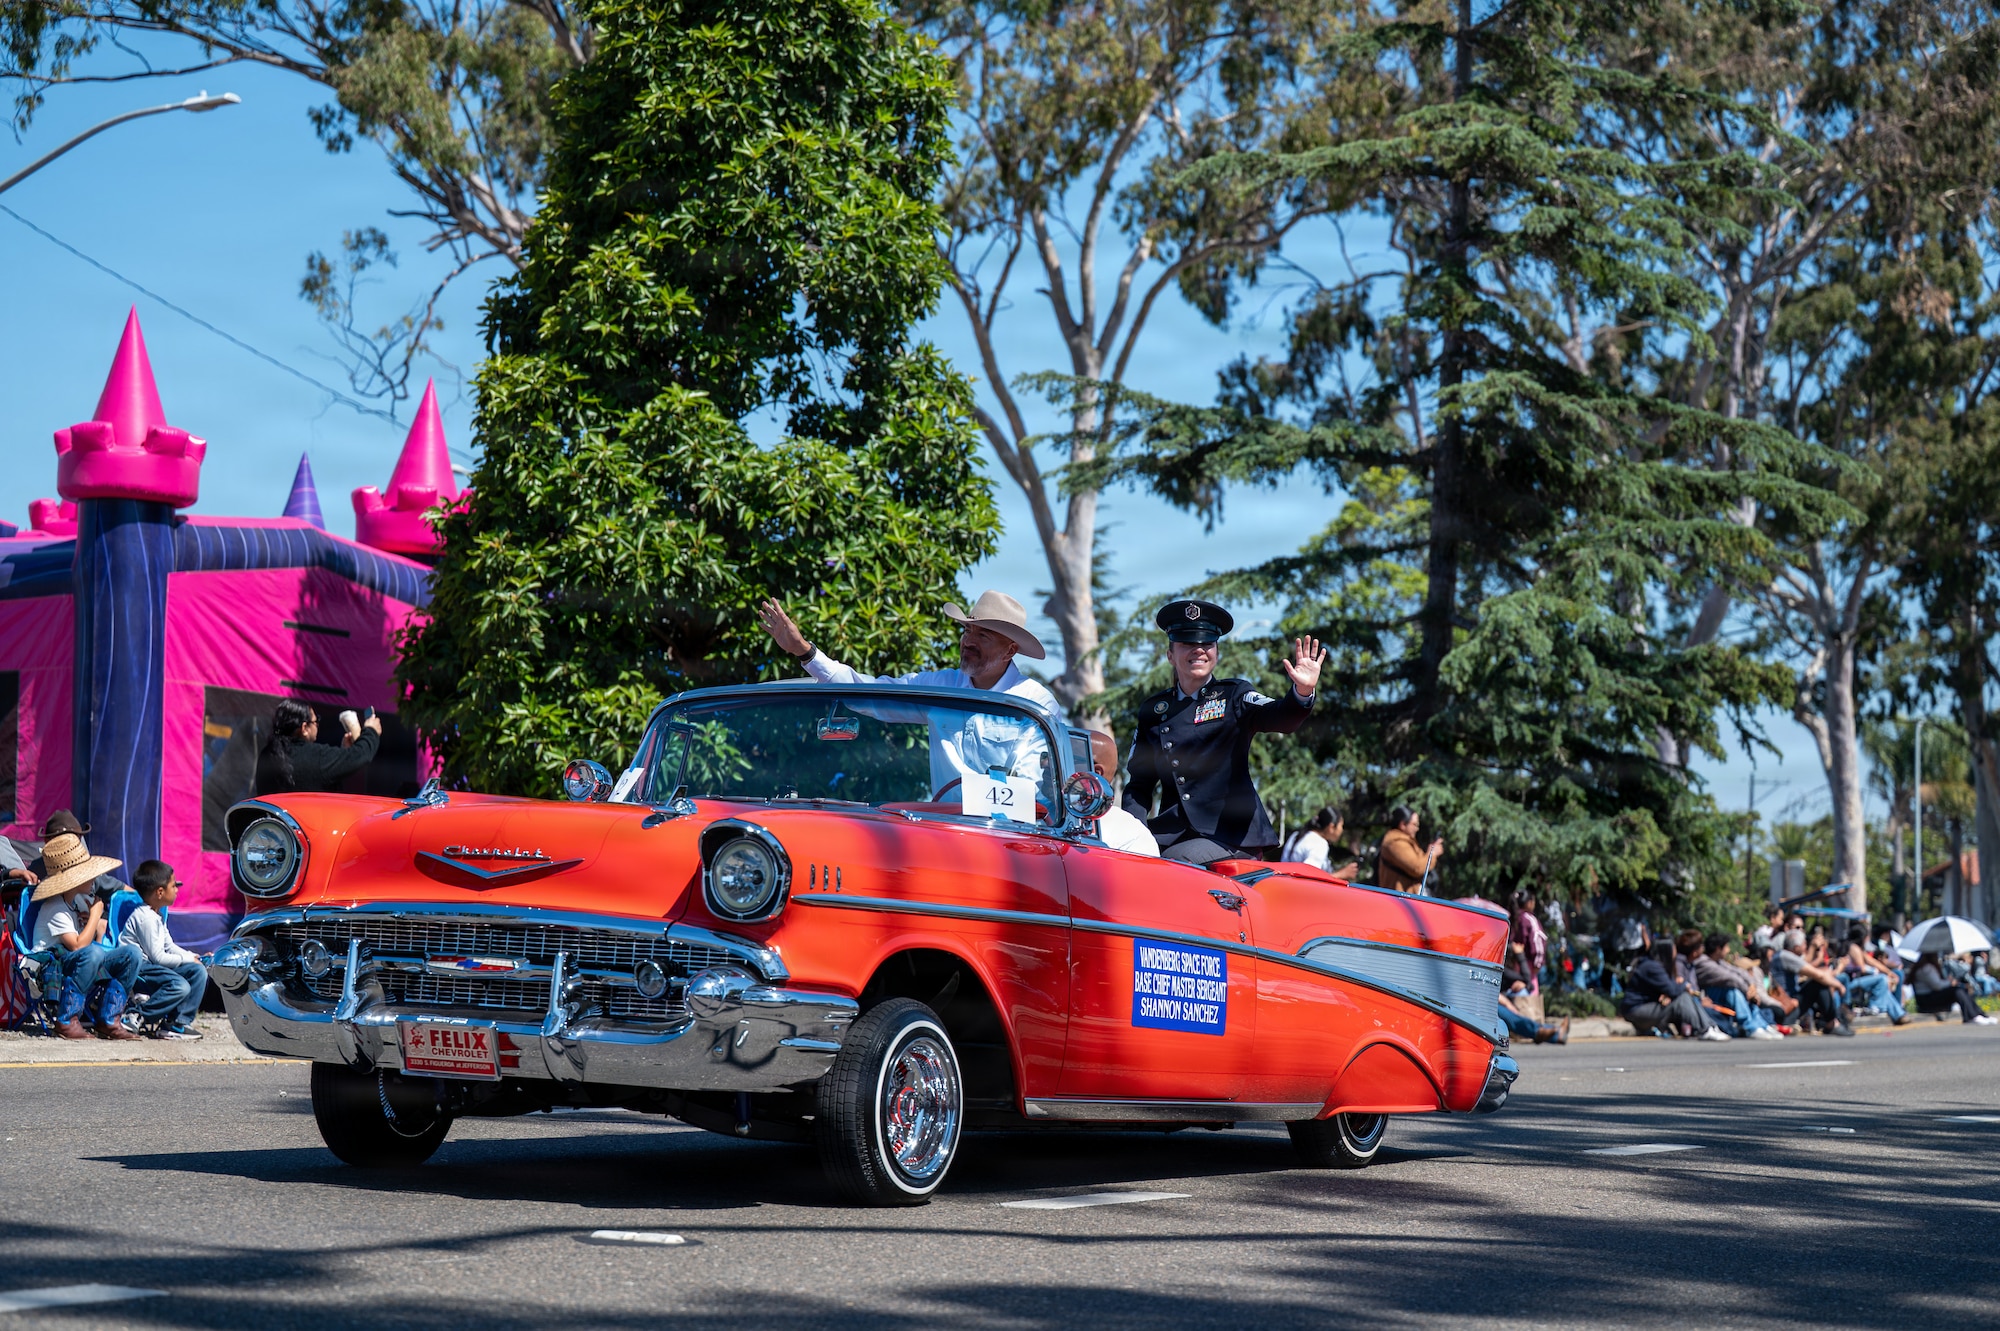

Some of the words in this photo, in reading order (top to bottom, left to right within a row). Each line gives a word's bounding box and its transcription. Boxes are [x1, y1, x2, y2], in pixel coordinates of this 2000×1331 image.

[986, 786, 1014, 806] 42
[1140, 946, 1180, 972] VANDENBERG
[1181, 952, 1200, 974] SPACE
[1200, 955, 1220, 978] FORCE
[1134, 971, 1152, 994] BASE
[1152, 973, 1171, 996] CHIEF
[1171, 976, 1196, 998] MASTER
[1196, 979, 1226, 1002] SERGEANT
[1140, 997, 1182, 1020] SHANNON
[1182, 1002, 1218, 1024] SANCHEZ
[430, 1030, 488, 1050] FELIX
[432, 1048, 488, 1058] CHEVROLET
